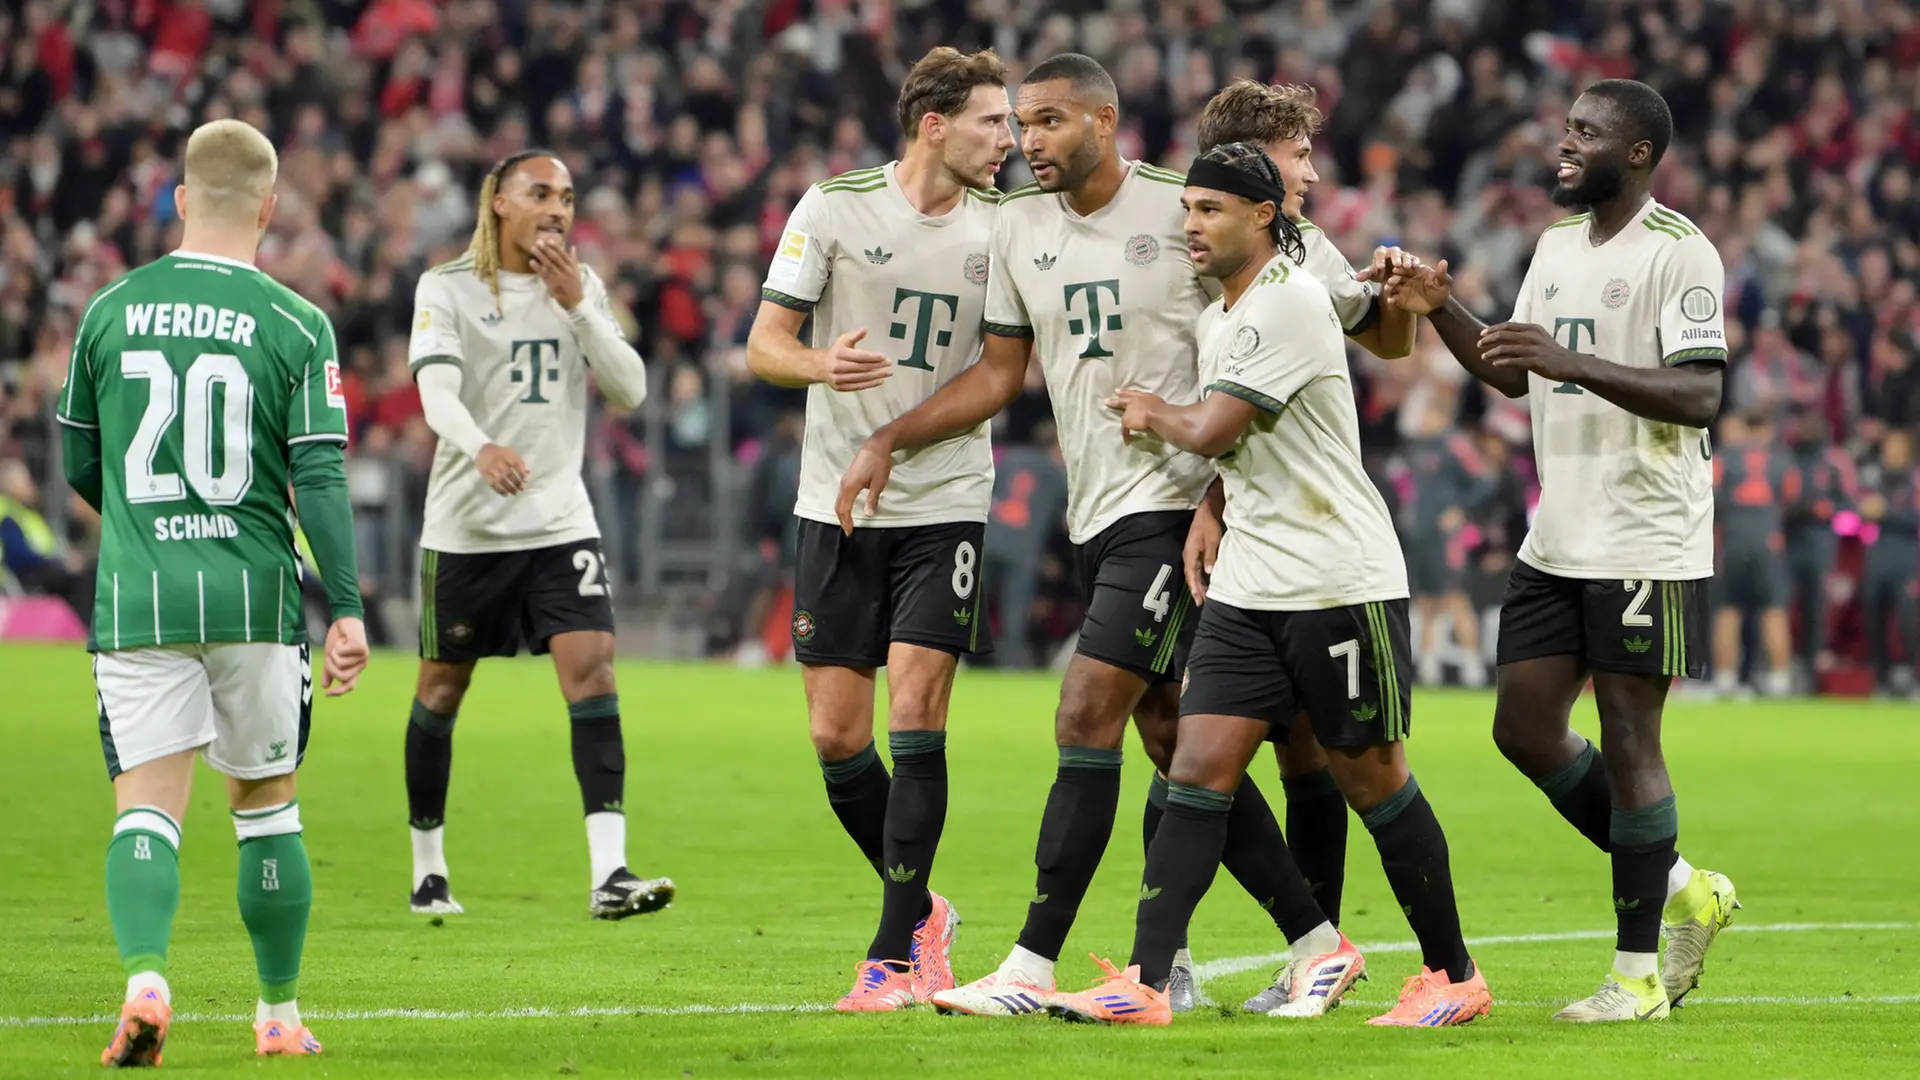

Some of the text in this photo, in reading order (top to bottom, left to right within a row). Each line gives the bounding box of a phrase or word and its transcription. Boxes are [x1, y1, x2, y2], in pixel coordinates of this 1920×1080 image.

[125, 303, 257, 347] WERDER
[1681, 328, 1722, 341] Allianz
[121, 351, 254, 506] 20
[154, 513, 239, 541] SCHMID
[572, 549, 612, 599] 2
[951, 540, 976, 600] 8
[1142, 563, 1173, 623] 4
[1622, 579, 1653, 627] 2
[1328, 638, 1360, 700] 7
